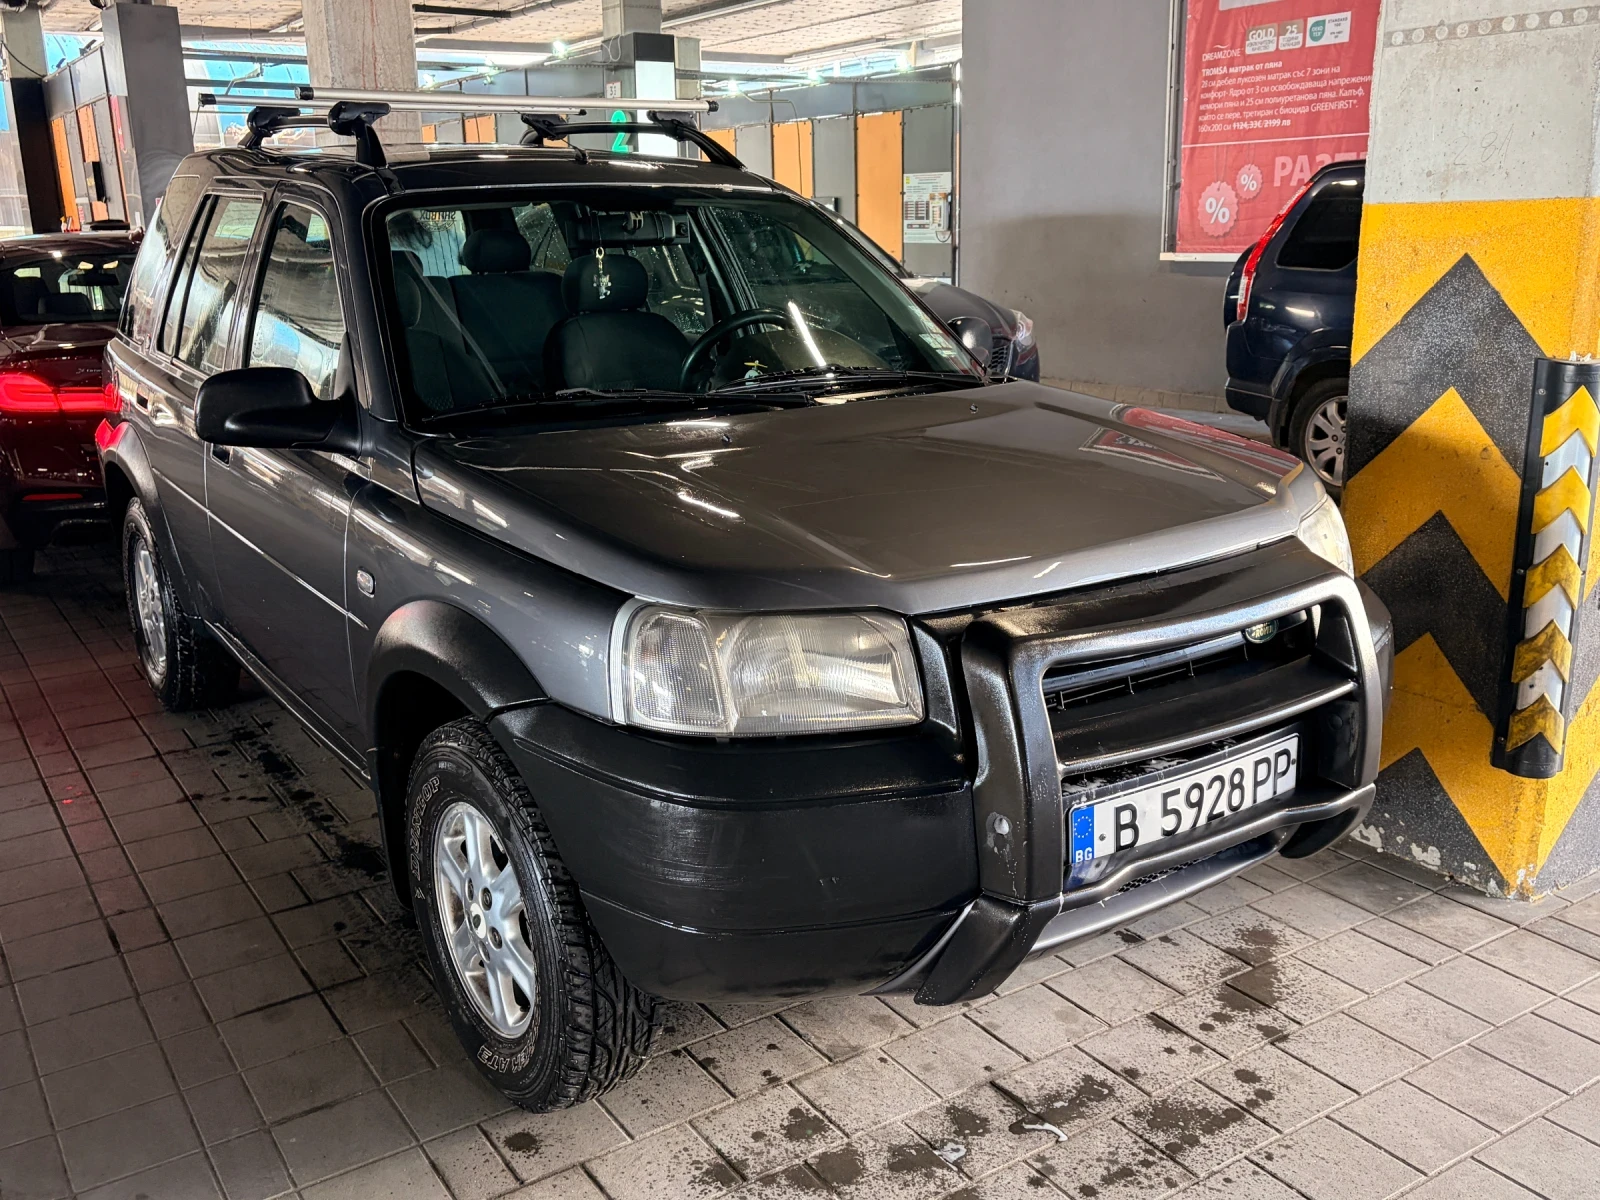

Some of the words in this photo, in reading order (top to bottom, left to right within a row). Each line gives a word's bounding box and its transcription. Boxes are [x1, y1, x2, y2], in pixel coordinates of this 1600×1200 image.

[1249, 28, 1275, 40] GOLD
[1286, 24, 1298, 36] 25
[1202, 49, 1241, 61] DREAMZONE
[1202, 66, 1228, 76] TROMSA
[1229, 64, 1254, 74] матрак
[1264, 61, 1282, 69] пяна
[1202, 80, 1208, 88] 28
[1216, 77, 1236, 88] дебел
[1237, 74, 1266, 86] луксозен
[1268, 72, 1291, 81] матрак
[1292, 70, 1305, 78] със
[1306, 68, 1311, 76] 7
[1229, 88, 1246, 97] Ядро
[1270, 80, 1327, 92] освобождаваща
[1200, 102, 1223, 110] мемори
[1246, 98, 1254, 106] 25
[1264, 93, 1317, 104] полиуретанова
[1199, 112, 1216, 121] който
[1243, 109, 1273, 118] третиран
[1280, 106, 1309, 115] биоцида
[611, 110, 630, 152] 2
[1198, 124, 1222, 132] 160x200
[1240, 174, 1257, 191] %
[1206, 197, 1230, 224] %
[410, 775, 440, 881] DUNLOP
[1075, 847, 1093, 863] BG
[476, 1045, 510, 1073] AT3
